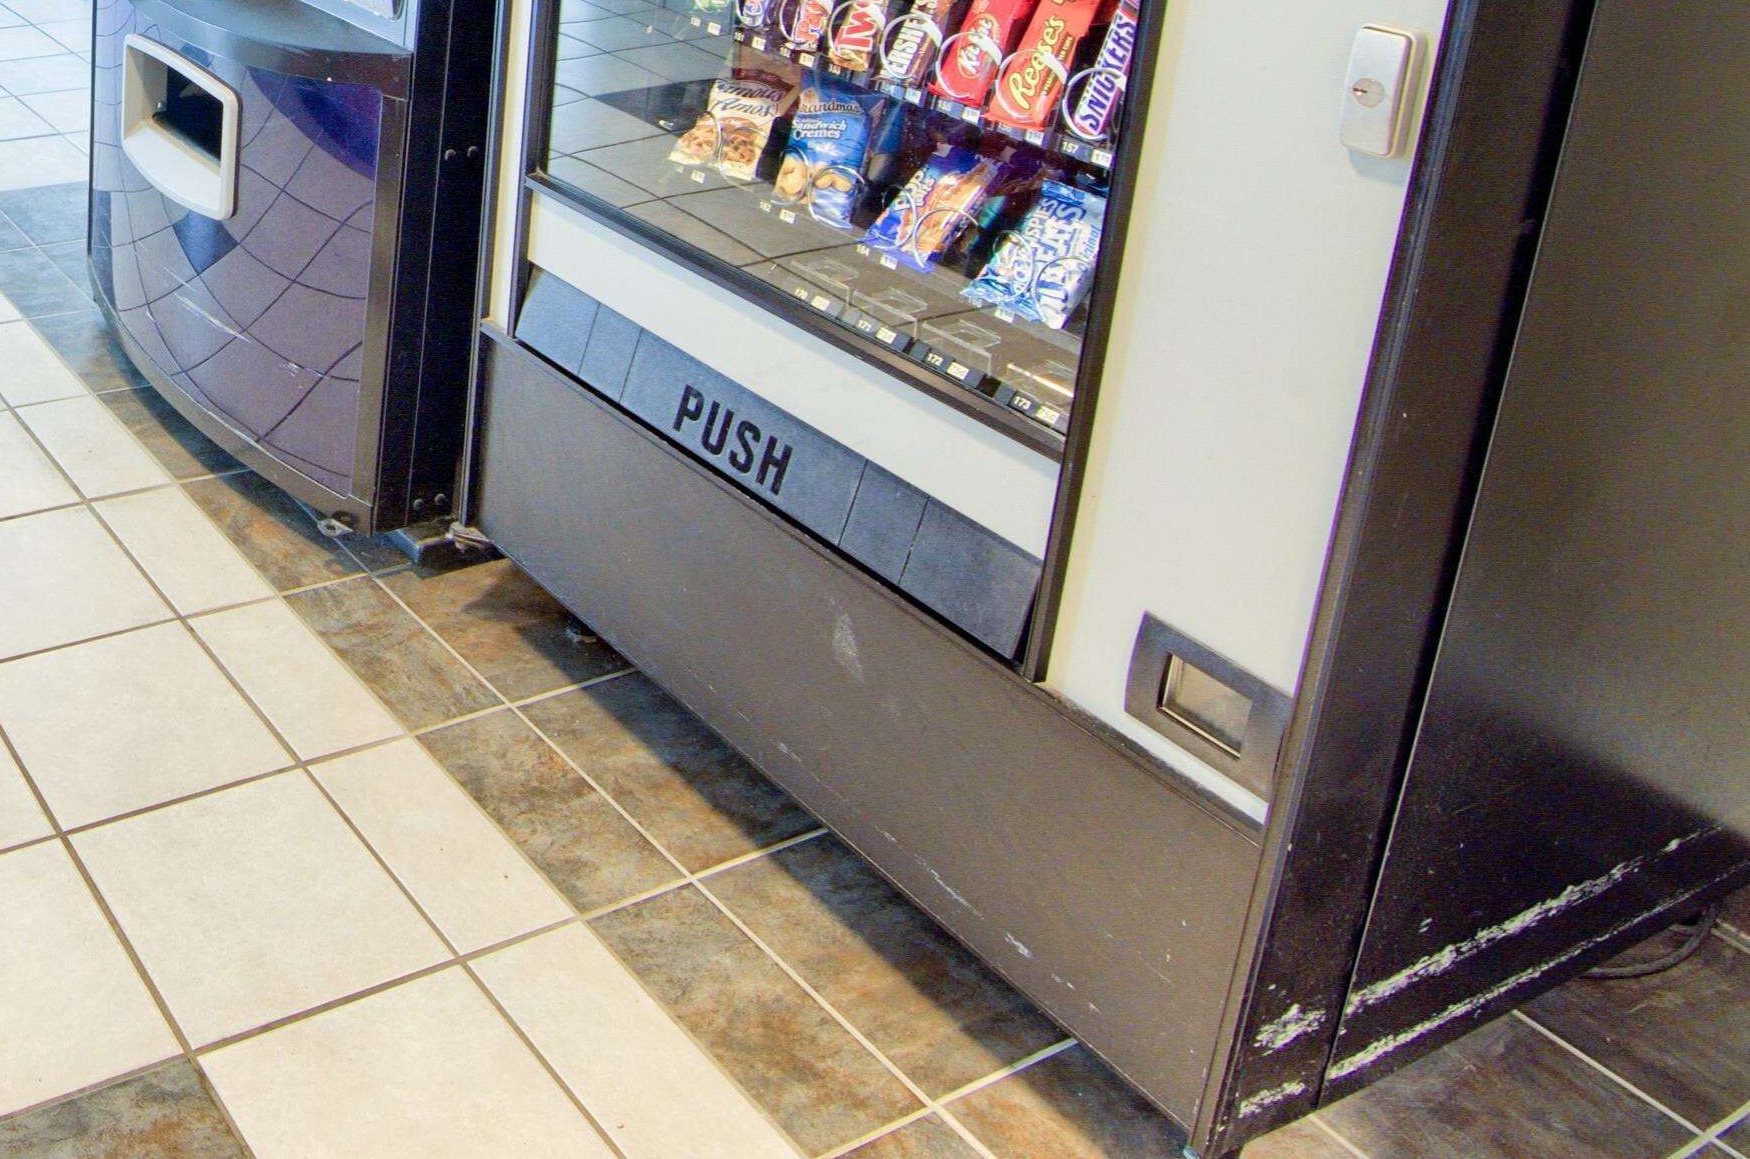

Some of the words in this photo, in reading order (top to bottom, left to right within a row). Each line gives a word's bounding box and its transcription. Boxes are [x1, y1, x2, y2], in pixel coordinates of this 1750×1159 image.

[1007, 14, 1067, 111] Reese's
[792, 118, 847, 131] Sandwich
[793, 129, 842, 140] Cremes
[1061, 141, 1079, 154] 157
[926, 351, 944, 367] 172
[1013, 395, 1031, 411] 173
[673, 384, 793, 496] PUSH
